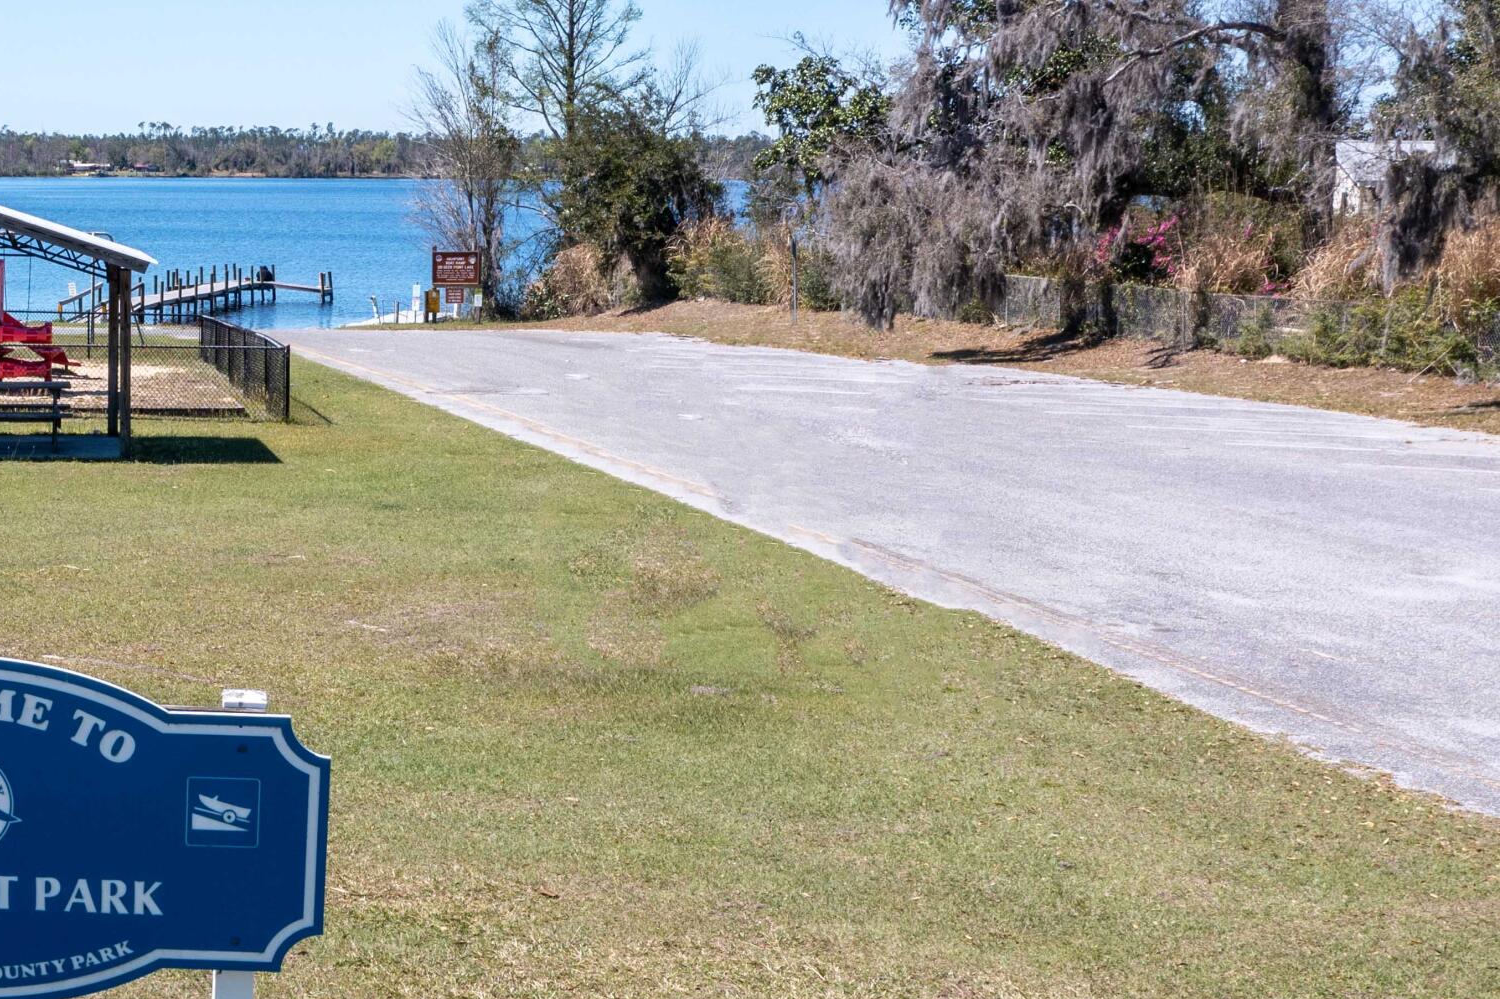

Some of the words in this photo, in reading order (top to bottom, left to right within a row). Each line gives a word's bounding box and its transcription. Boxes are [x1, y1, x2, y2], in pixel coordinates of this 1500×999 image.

[72, 709, 136, 763] TO
[34, 876, 163, 916] PARK
[71, 940, 135, 970] PARK
